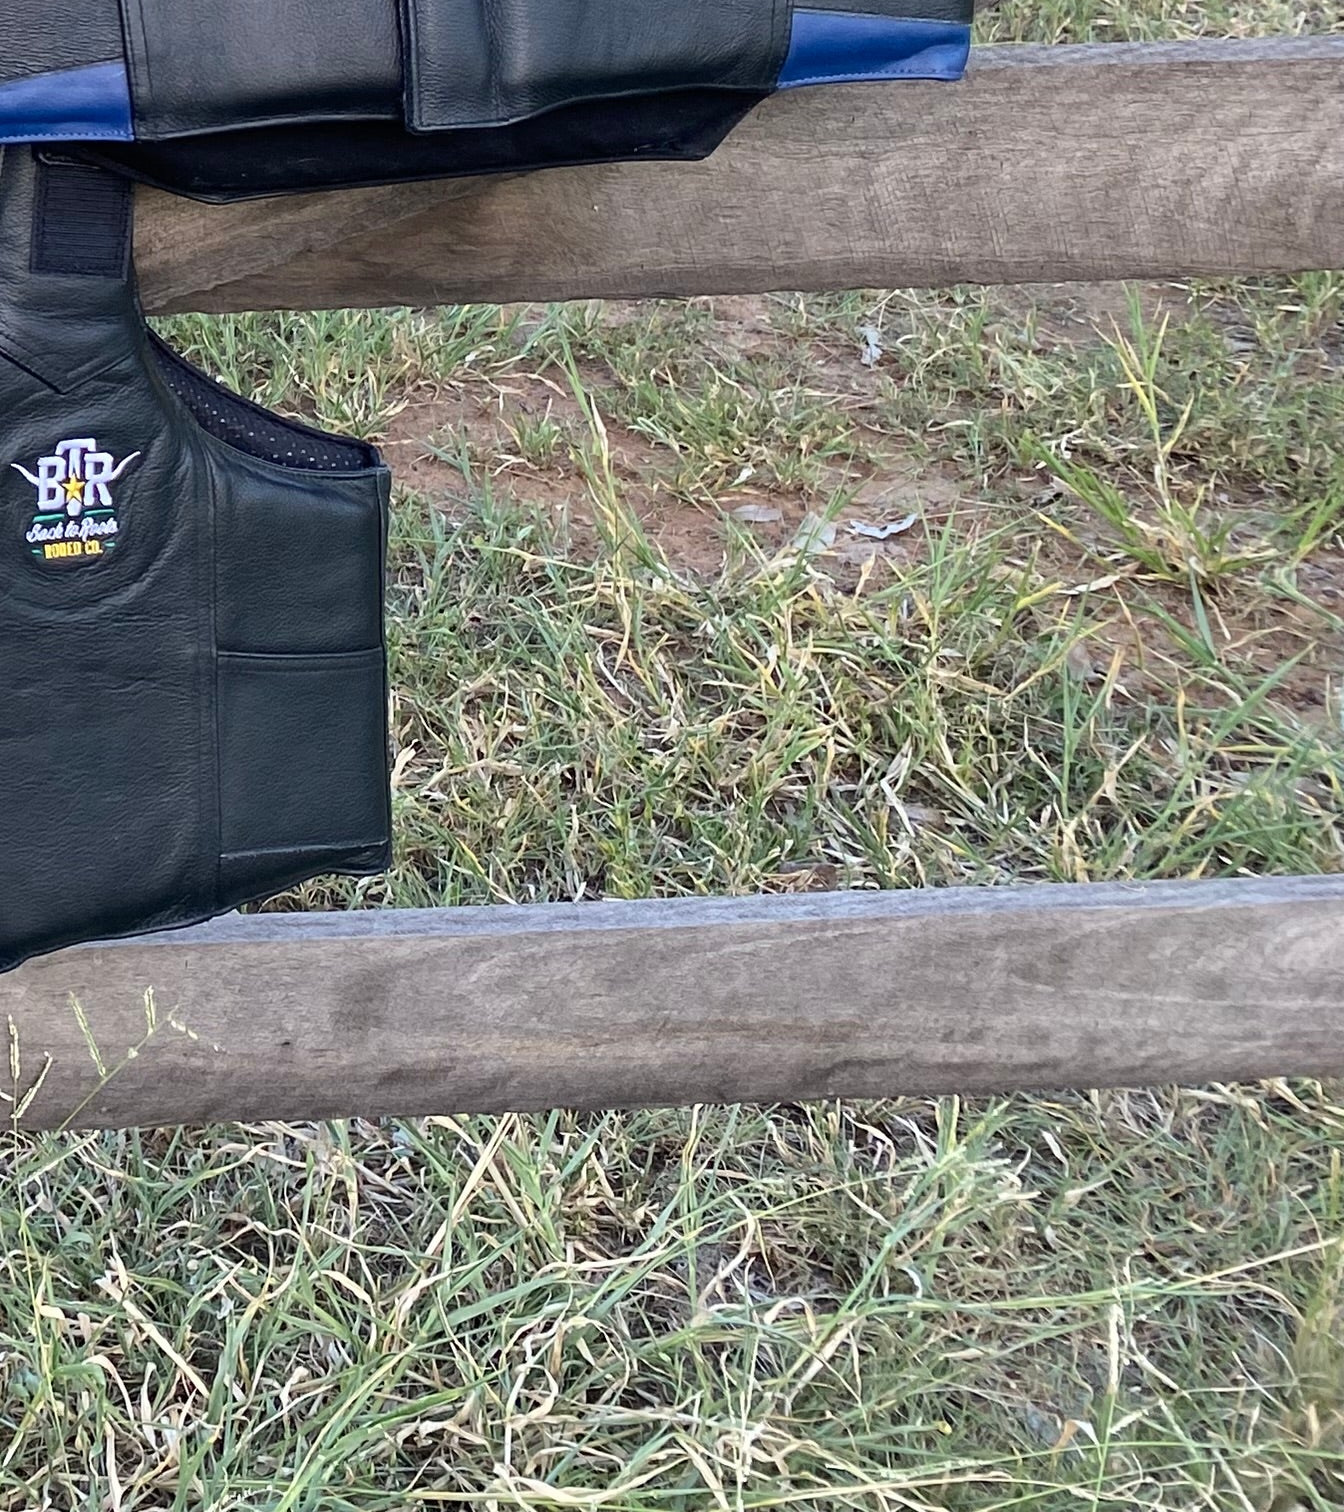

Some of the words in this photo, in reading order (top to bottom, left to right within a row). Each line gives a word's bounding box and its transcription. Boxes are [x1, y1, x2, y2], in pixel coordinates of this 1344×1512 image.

[37, 438, 114, 516] BTR
[25, 522, 64, 543] Back
[64, 519, 80, 538] to
[78, 516, 119, 542] Roots
[43, 541, 82, 559] RODEO
